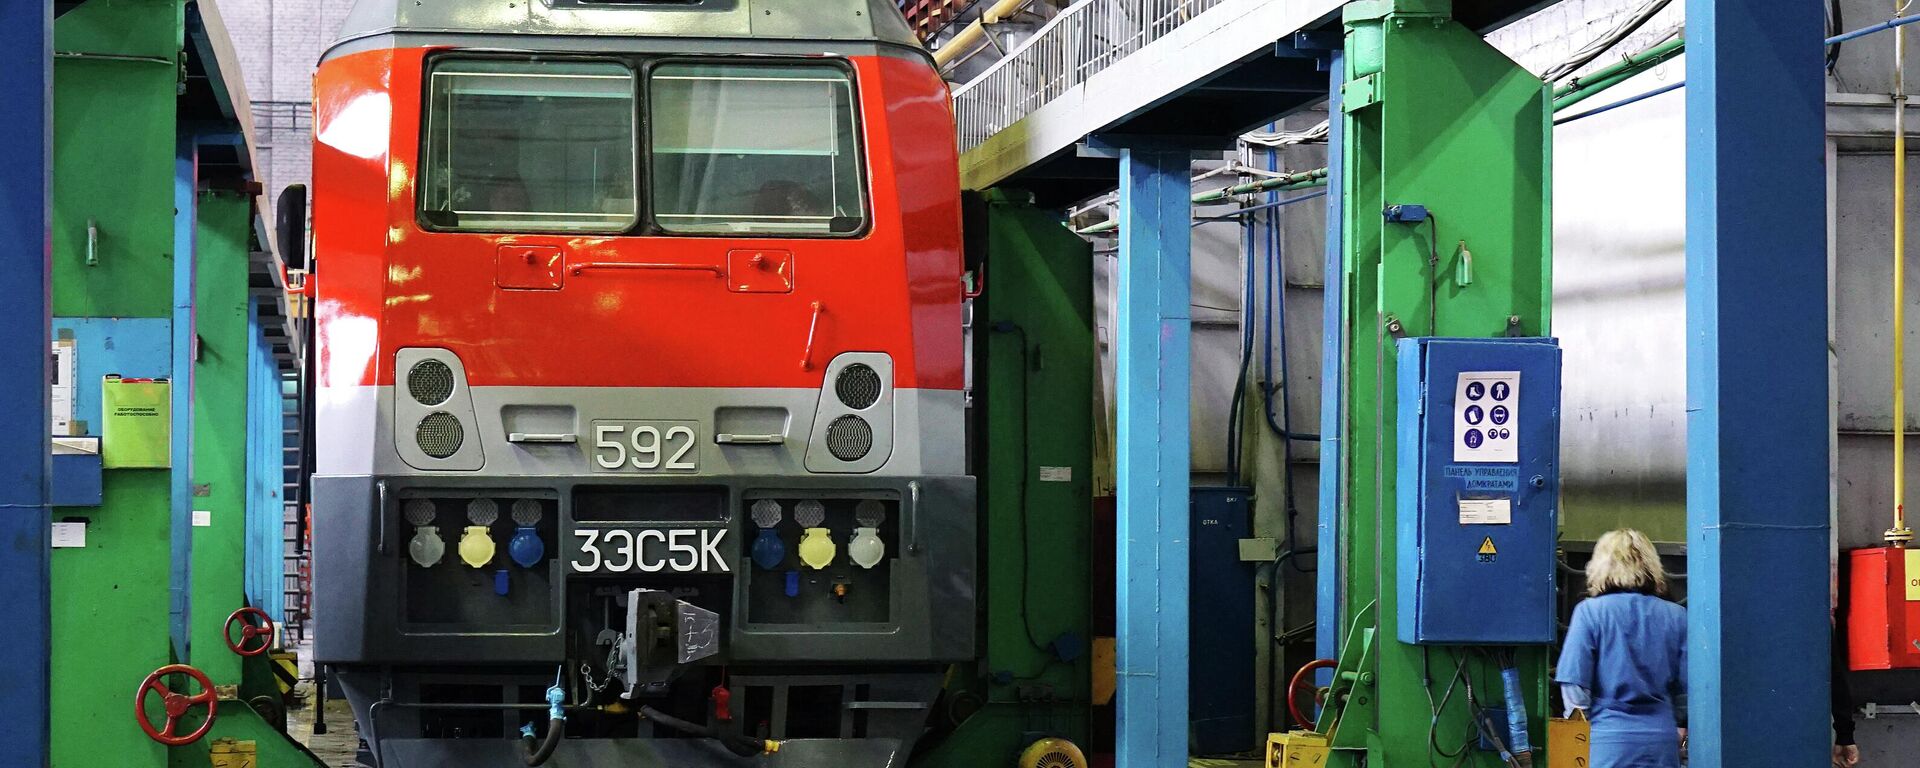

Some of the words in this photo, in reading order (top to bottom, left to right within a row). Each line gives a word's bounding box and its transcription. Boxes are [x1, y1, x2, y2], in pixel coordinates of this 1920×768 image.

[596, 425, 695, 469] 592
[1445, 467, 1473, 477] ПАНЕЛЬ
[1474, 467, 1518, 477] УПРАВЛЕНИЯ
[1466, 480, 1514, 489] ДОМКРАТАМИ
[570, 528, 731, 573] 3ЭС5К
